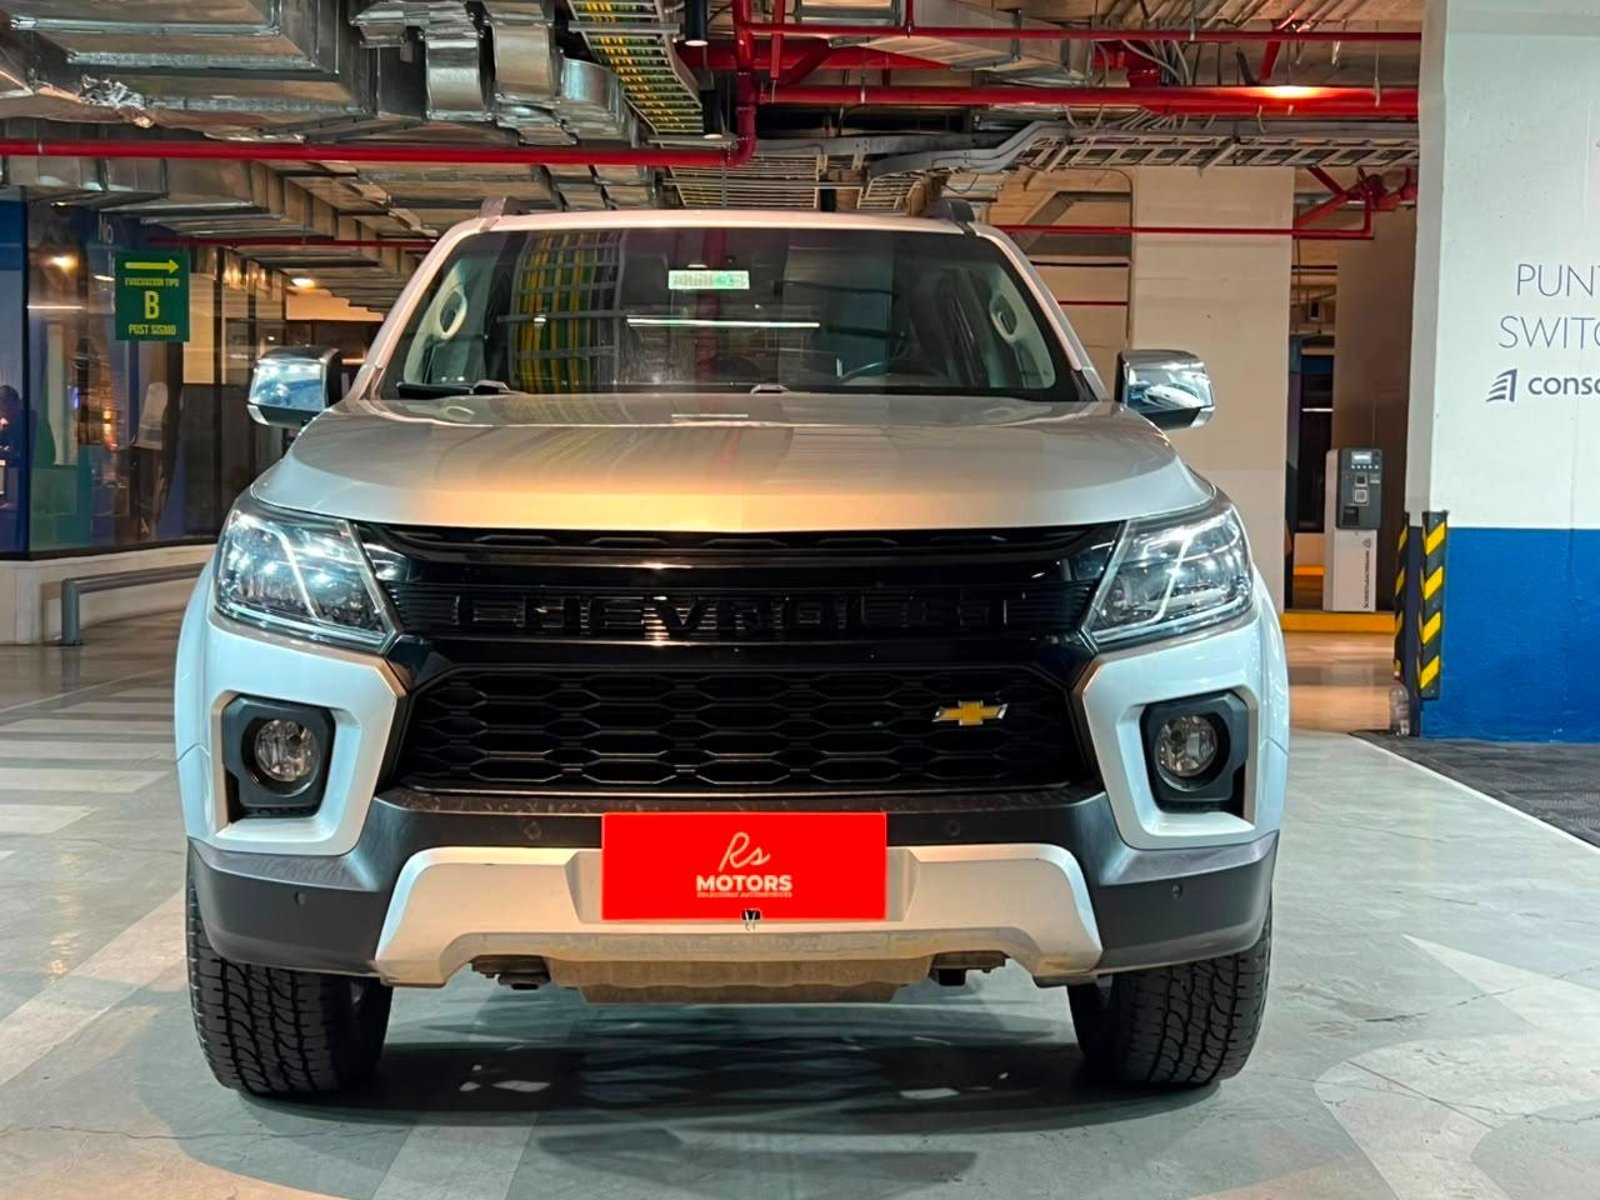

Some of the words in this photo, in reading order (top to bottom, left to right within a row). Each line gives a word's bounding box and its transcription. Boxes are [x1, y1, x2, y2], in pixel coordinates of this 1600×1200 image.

[1517, 263, 1600, 297] PUN
[144, 290, 160, 320] B
[1498, 315, 1600, 349] SWIT
